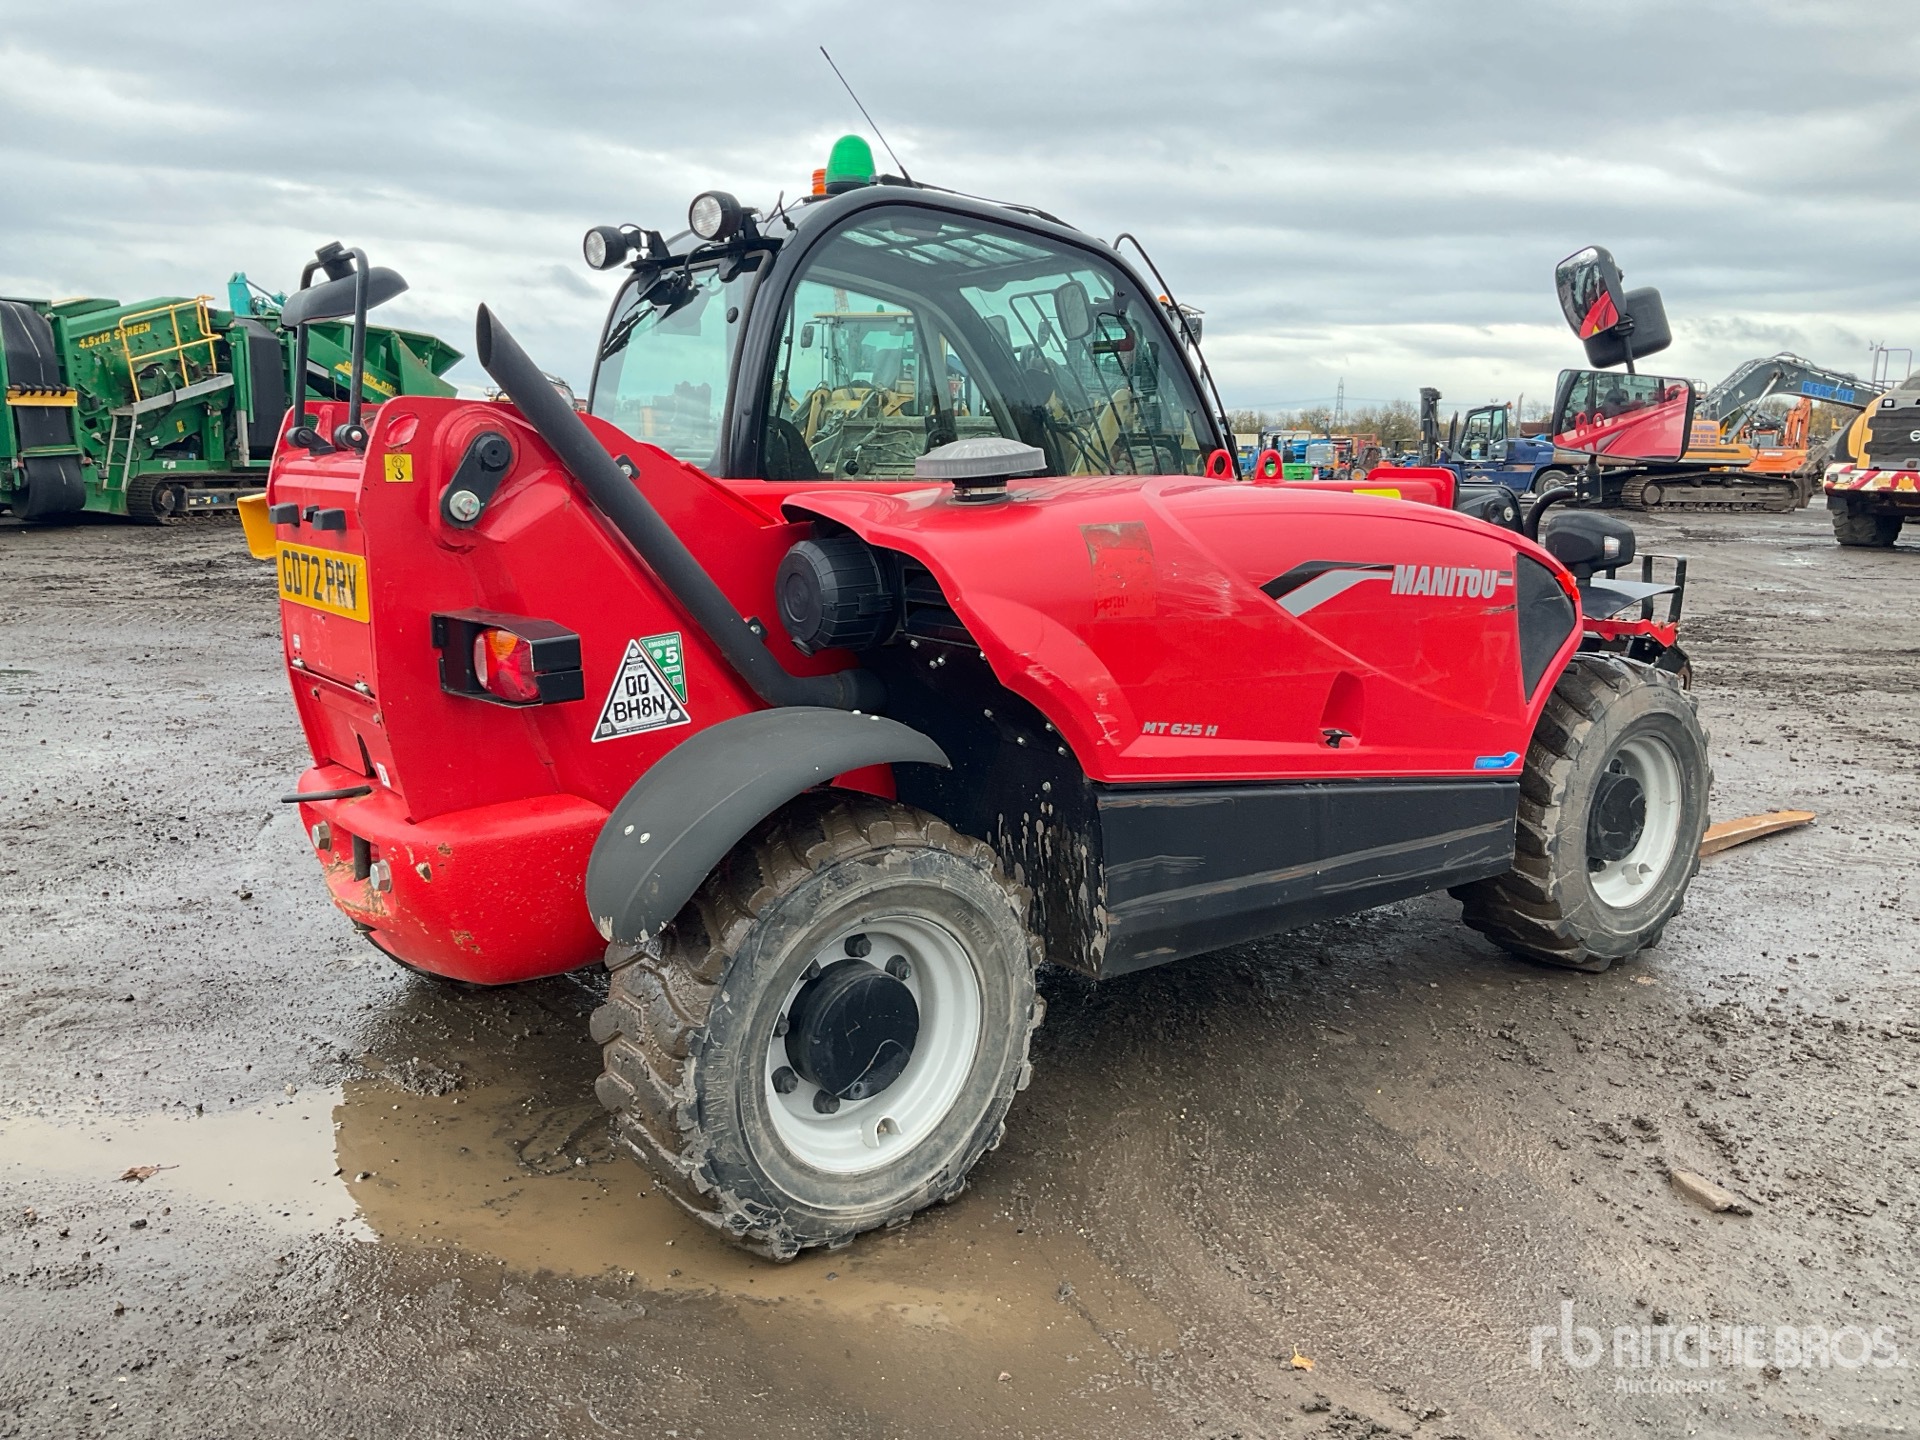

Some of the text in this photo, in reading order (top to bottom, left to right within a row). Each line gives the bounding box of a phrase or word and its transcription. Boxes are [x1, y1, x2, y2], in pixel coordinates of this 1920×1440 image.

[79, 322, 151, 349] 4.5x12 SREEN
[282, 549, 357, 611] GD72 PRV
[1391, 564, 1498, 598] MANITOU
[665, 646, 679, 664] 5
[613, 694, 666, 723] BH8N
[1142, 721, 1219, 737] MT 625 H
